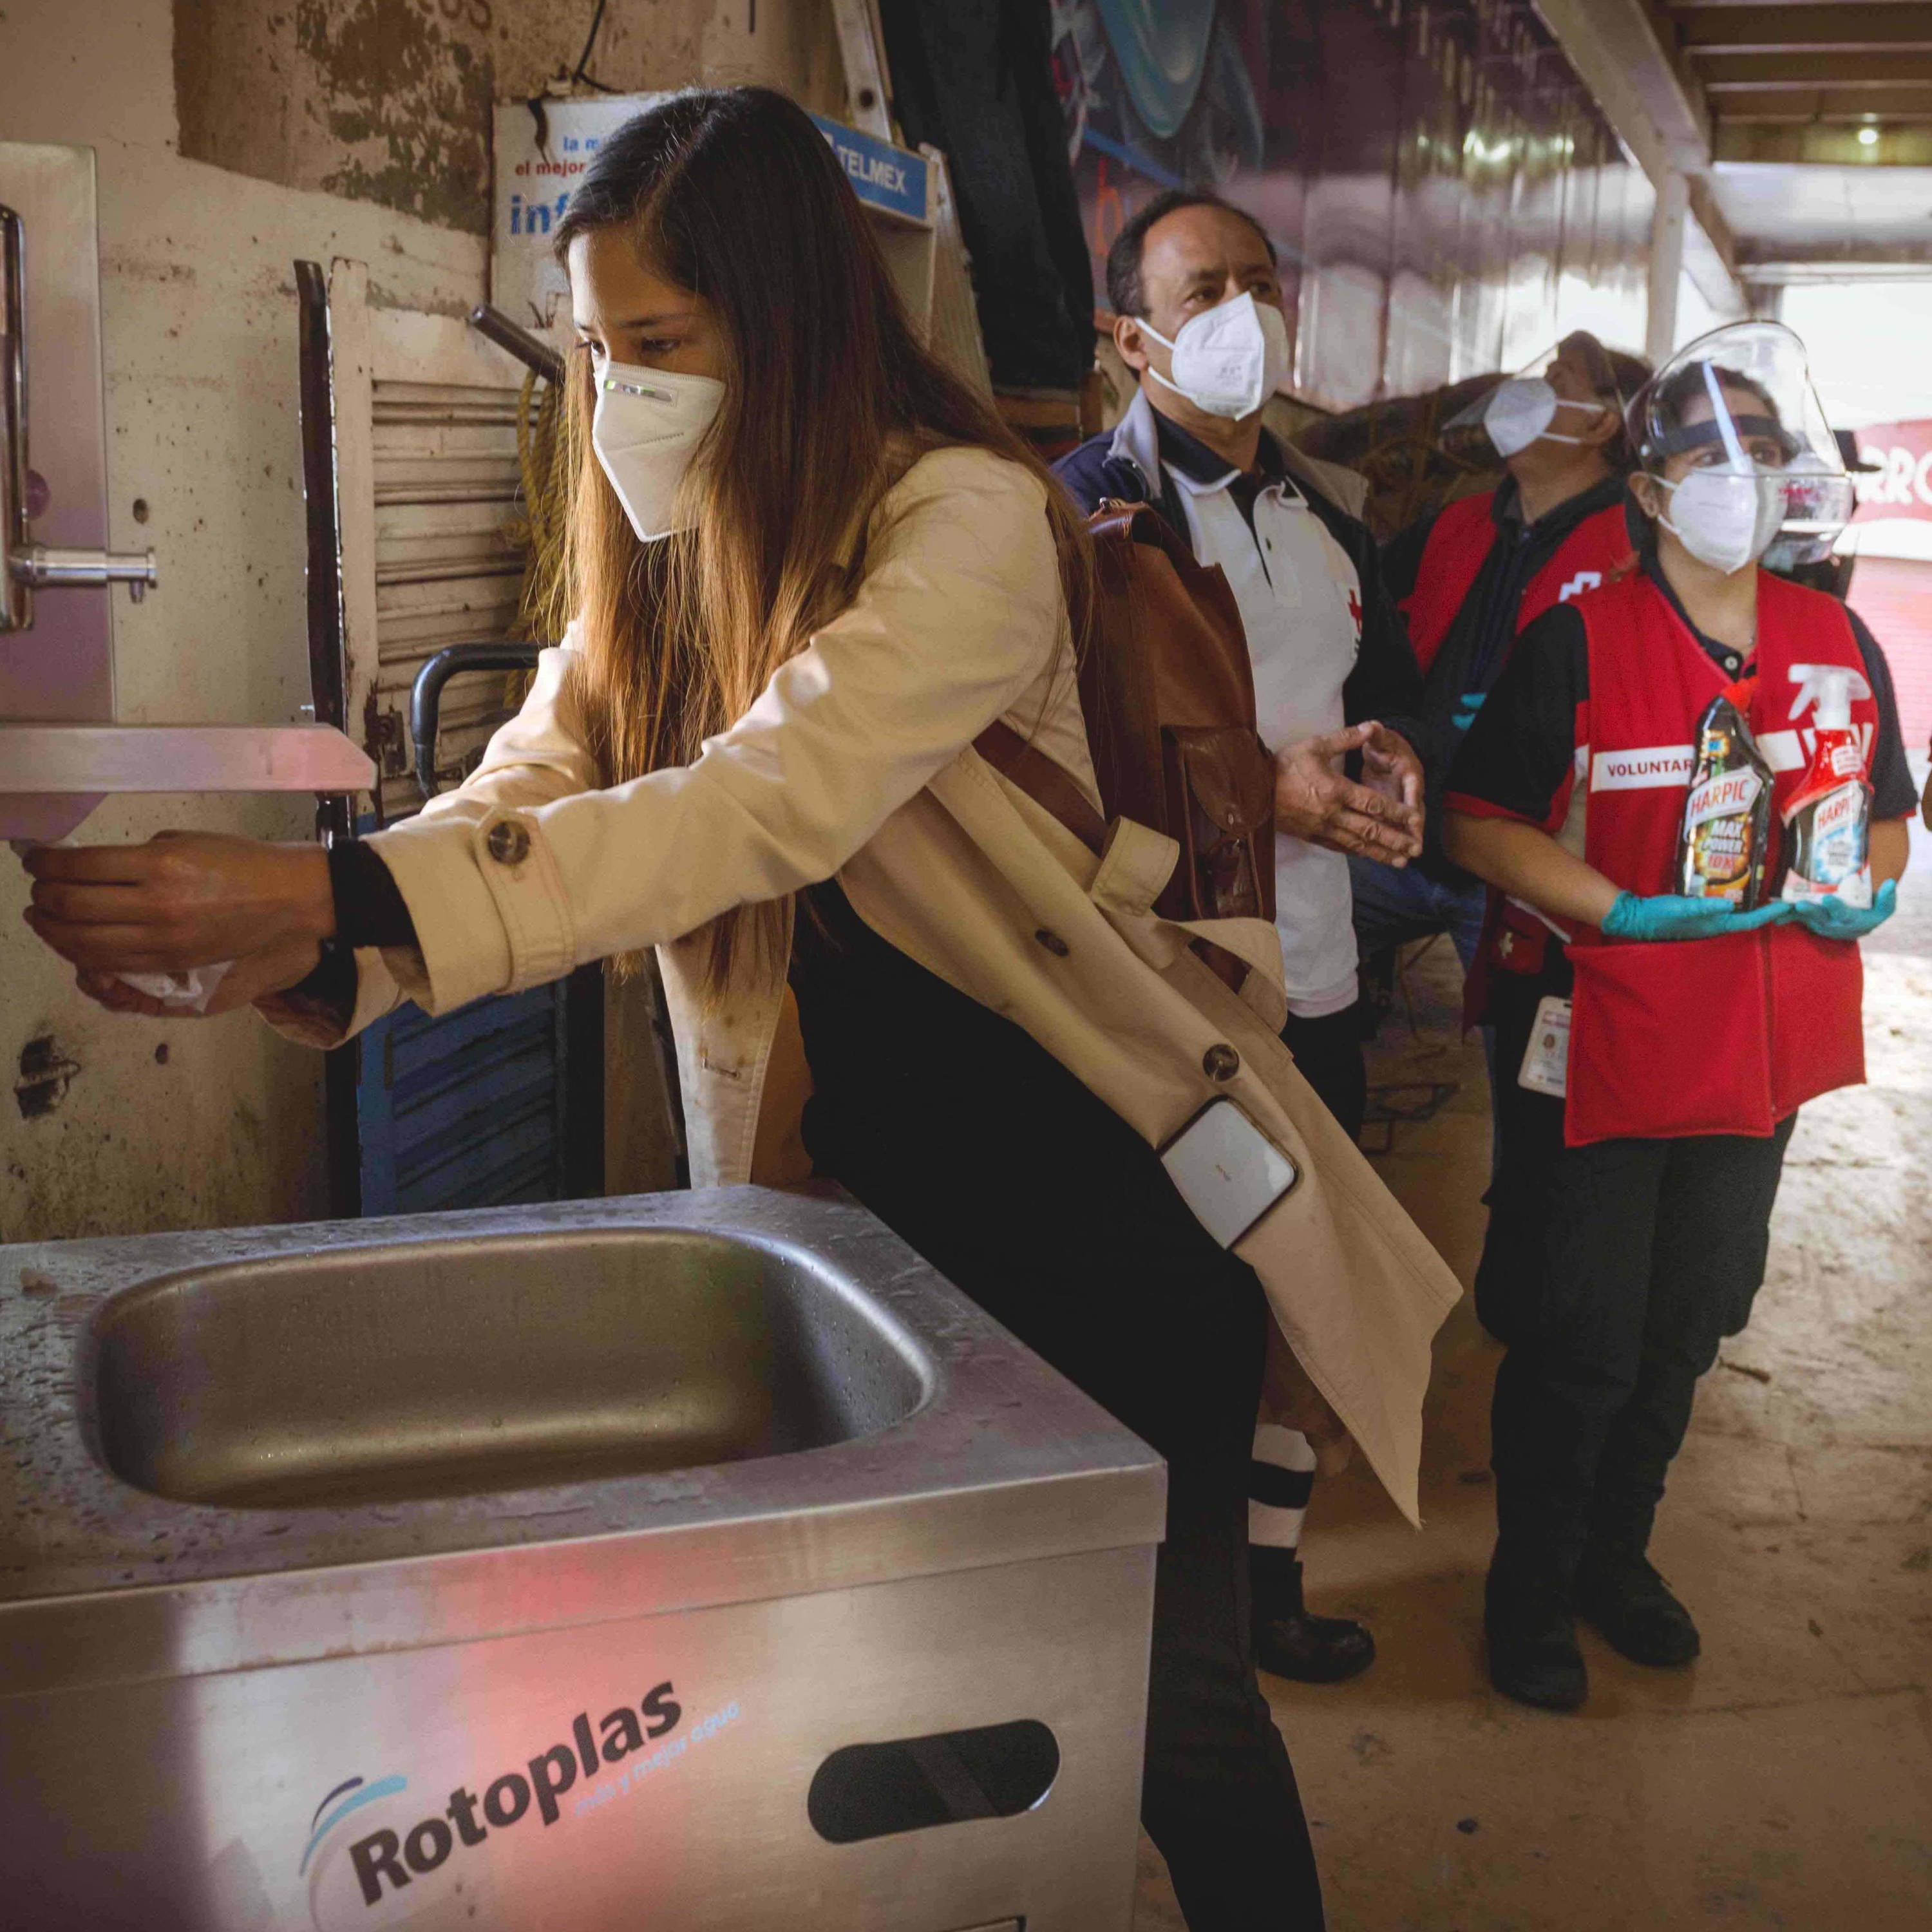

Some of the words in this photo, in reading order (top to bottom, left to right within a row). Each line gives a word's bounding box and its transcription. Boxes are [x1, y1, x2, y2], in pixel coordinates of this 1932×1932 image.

[563, 137, 578, 151] la
[516, 162, 529, 176] el
[536, 160, 585, 176] mejor
[838, 145, 906, 194] TELMEX
[1691, 779, 1748, 814] HARPIC
[1818, 797, 1853, 829] HARPI
[634, 1737, 687, 1781] mejor
[691, 1701, 739, 1742] agua
[349, 1681, 681, 1906] Rotoplas
